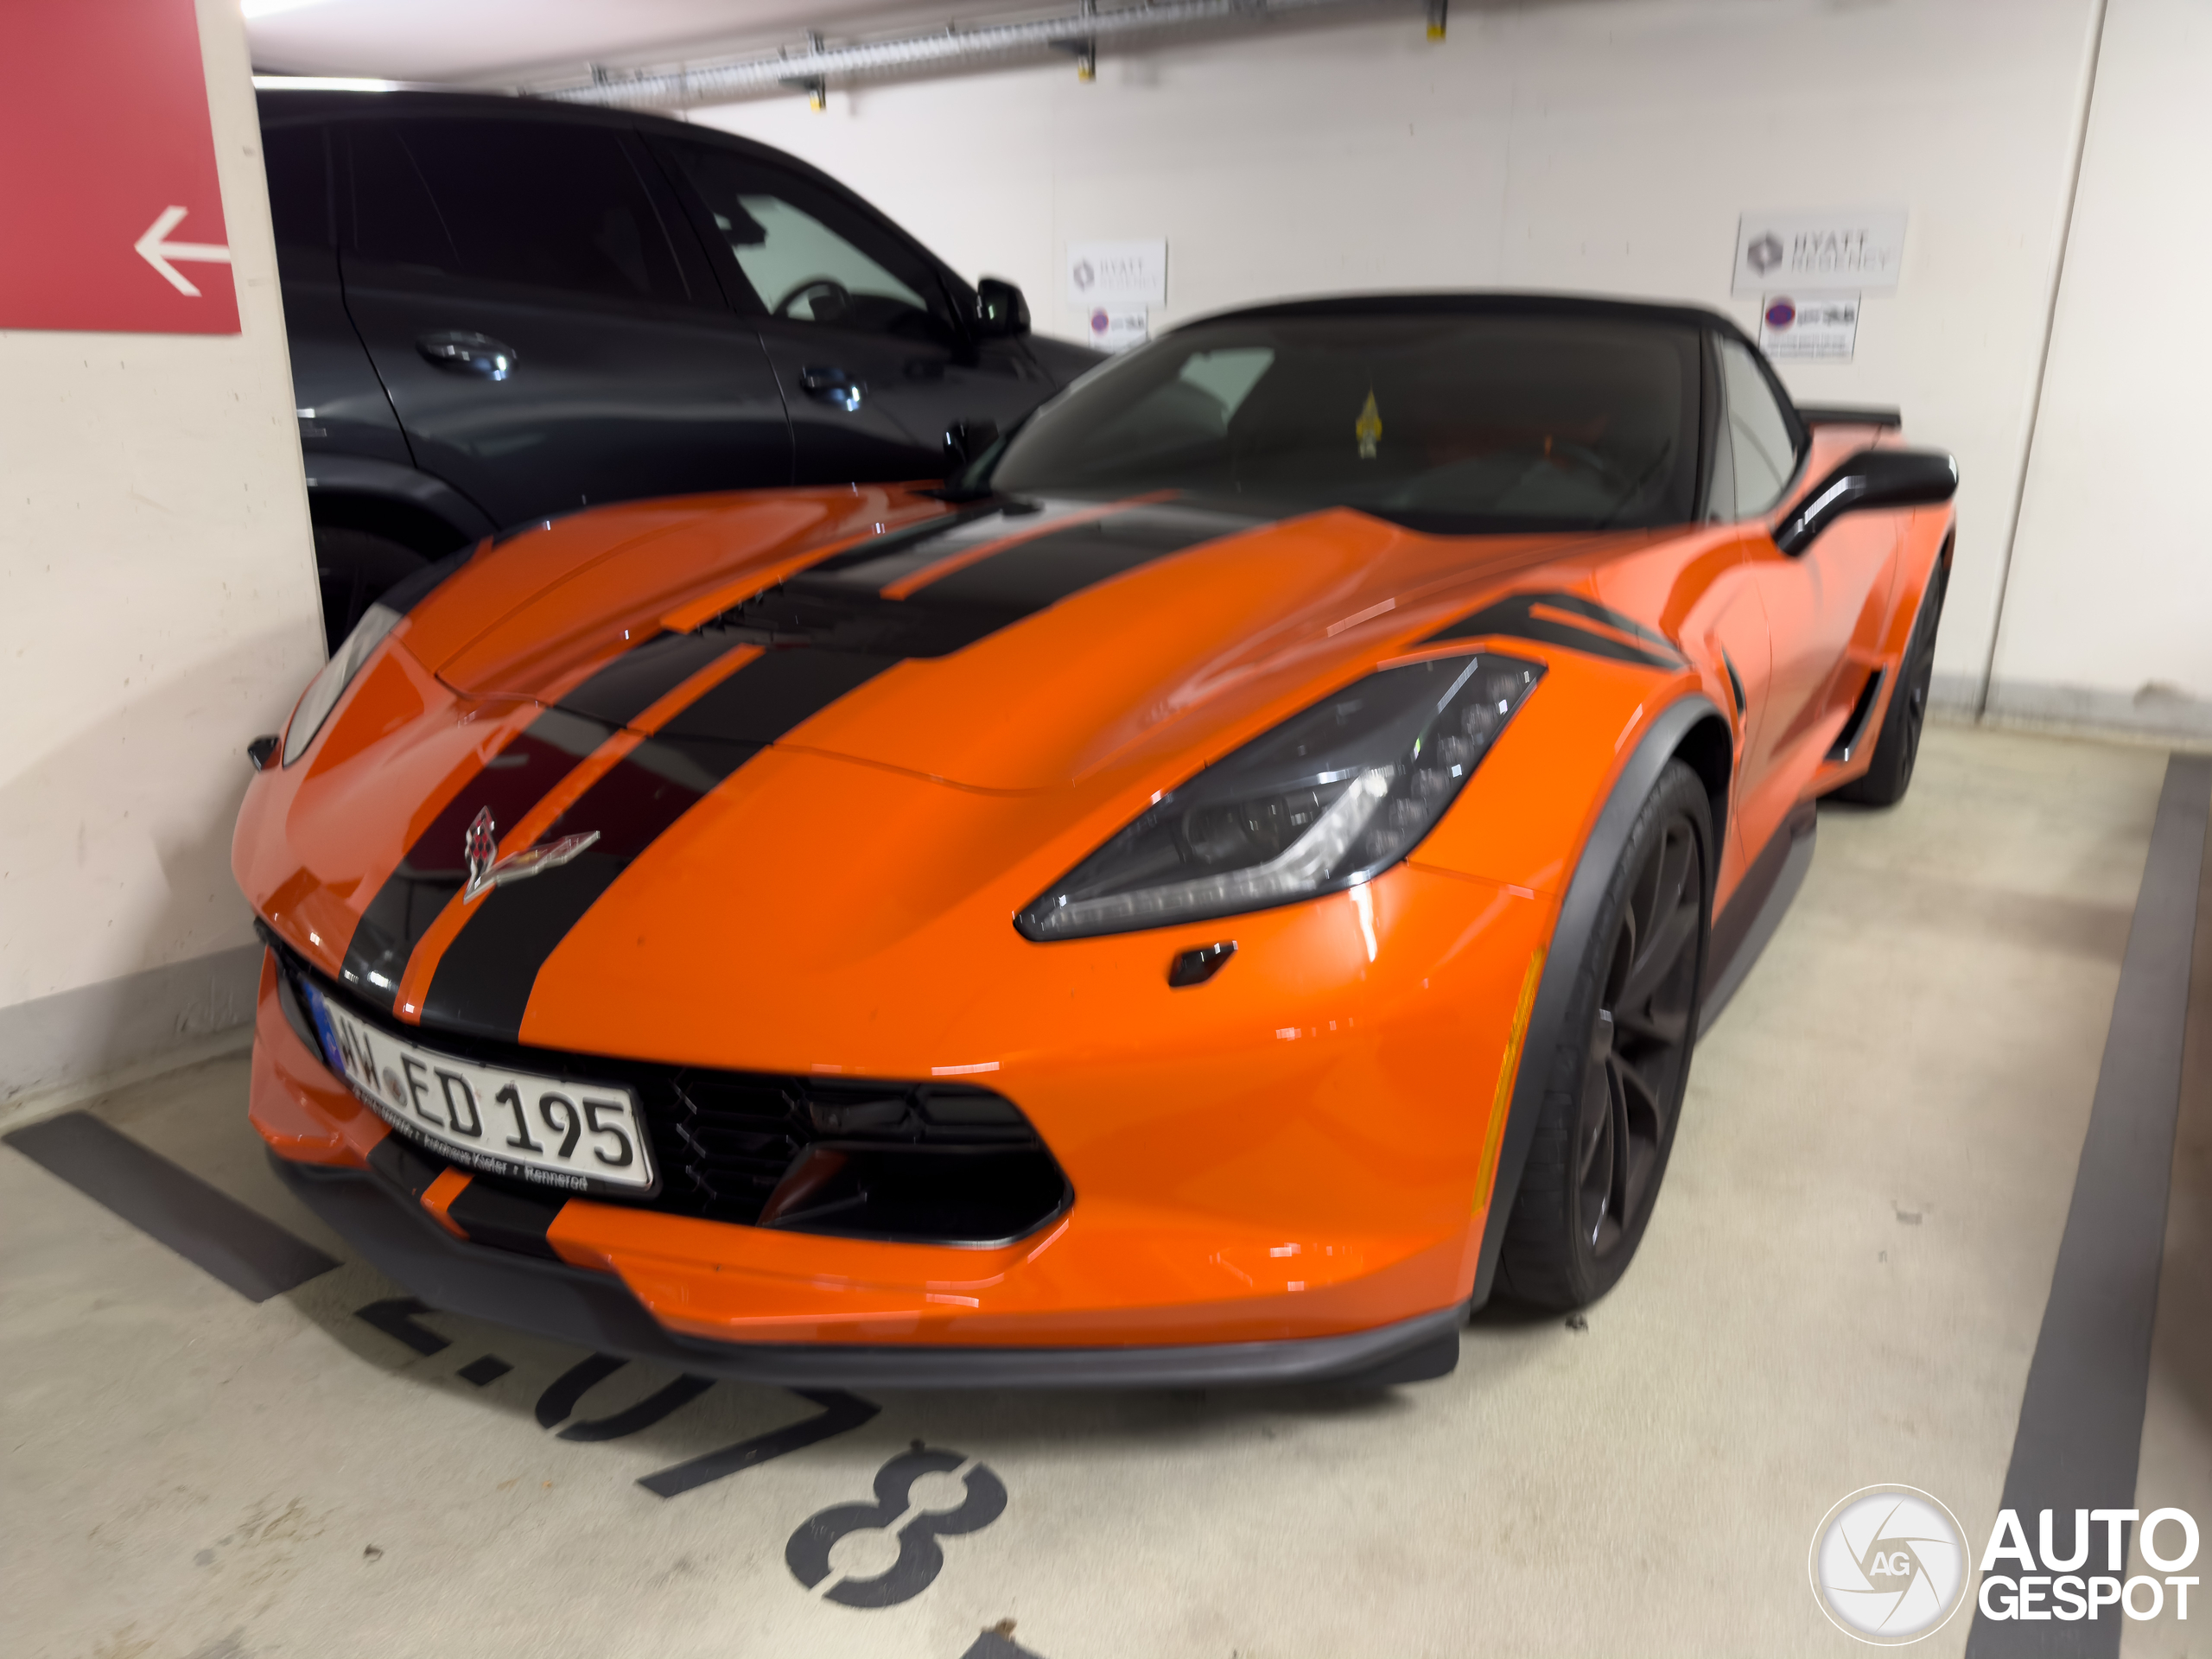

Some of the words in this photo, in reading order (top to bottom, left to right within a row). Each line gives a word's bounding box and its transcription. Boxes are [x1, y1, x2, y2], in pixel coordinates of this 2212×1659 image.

[1792, 229, 1869, 254] HYATT
[326, 1004, 381, 1092] WW
[400, 1052, 483, 1137] ED
[495, 1081, 633, 1166] 195
